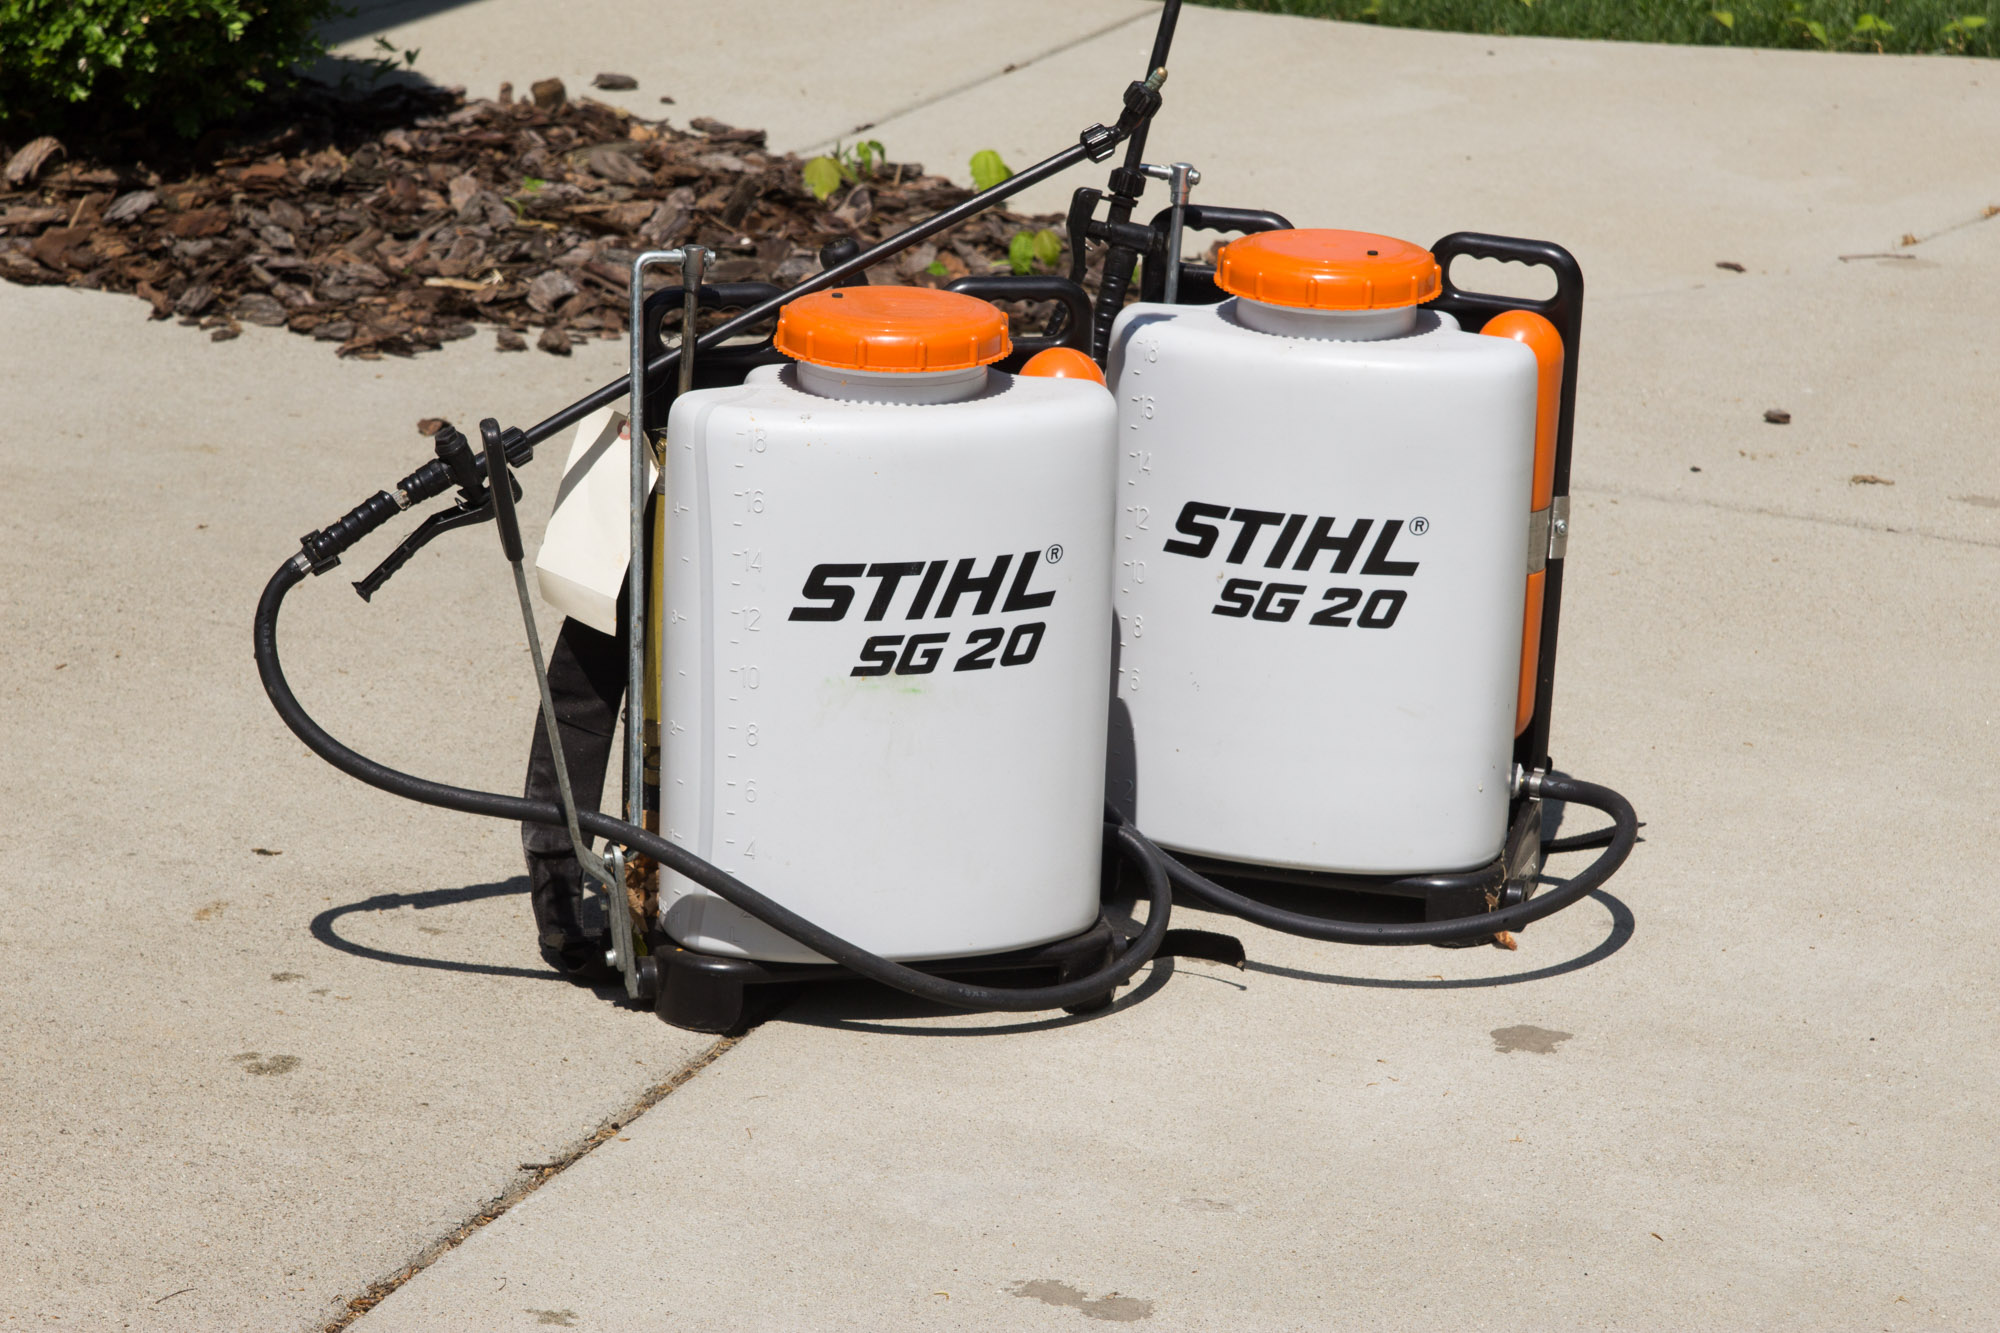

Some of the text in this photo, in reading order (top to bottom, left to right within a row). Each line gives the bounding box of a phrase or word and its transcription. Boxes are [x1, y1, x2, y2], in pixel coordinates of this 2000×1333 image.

[1162, 500, 1420, 577] STIHL
[787, 550, 1057, 622] STIHL
[1211, 578, 1408, 629] SG 20
[741, 605, 761, 632] 12
[849, 621, 1047, 677] SG 20
[745, 721, 760, 747] 8
[744, 777, 758, 804] 6
[743, 835, 757, 861] 4
